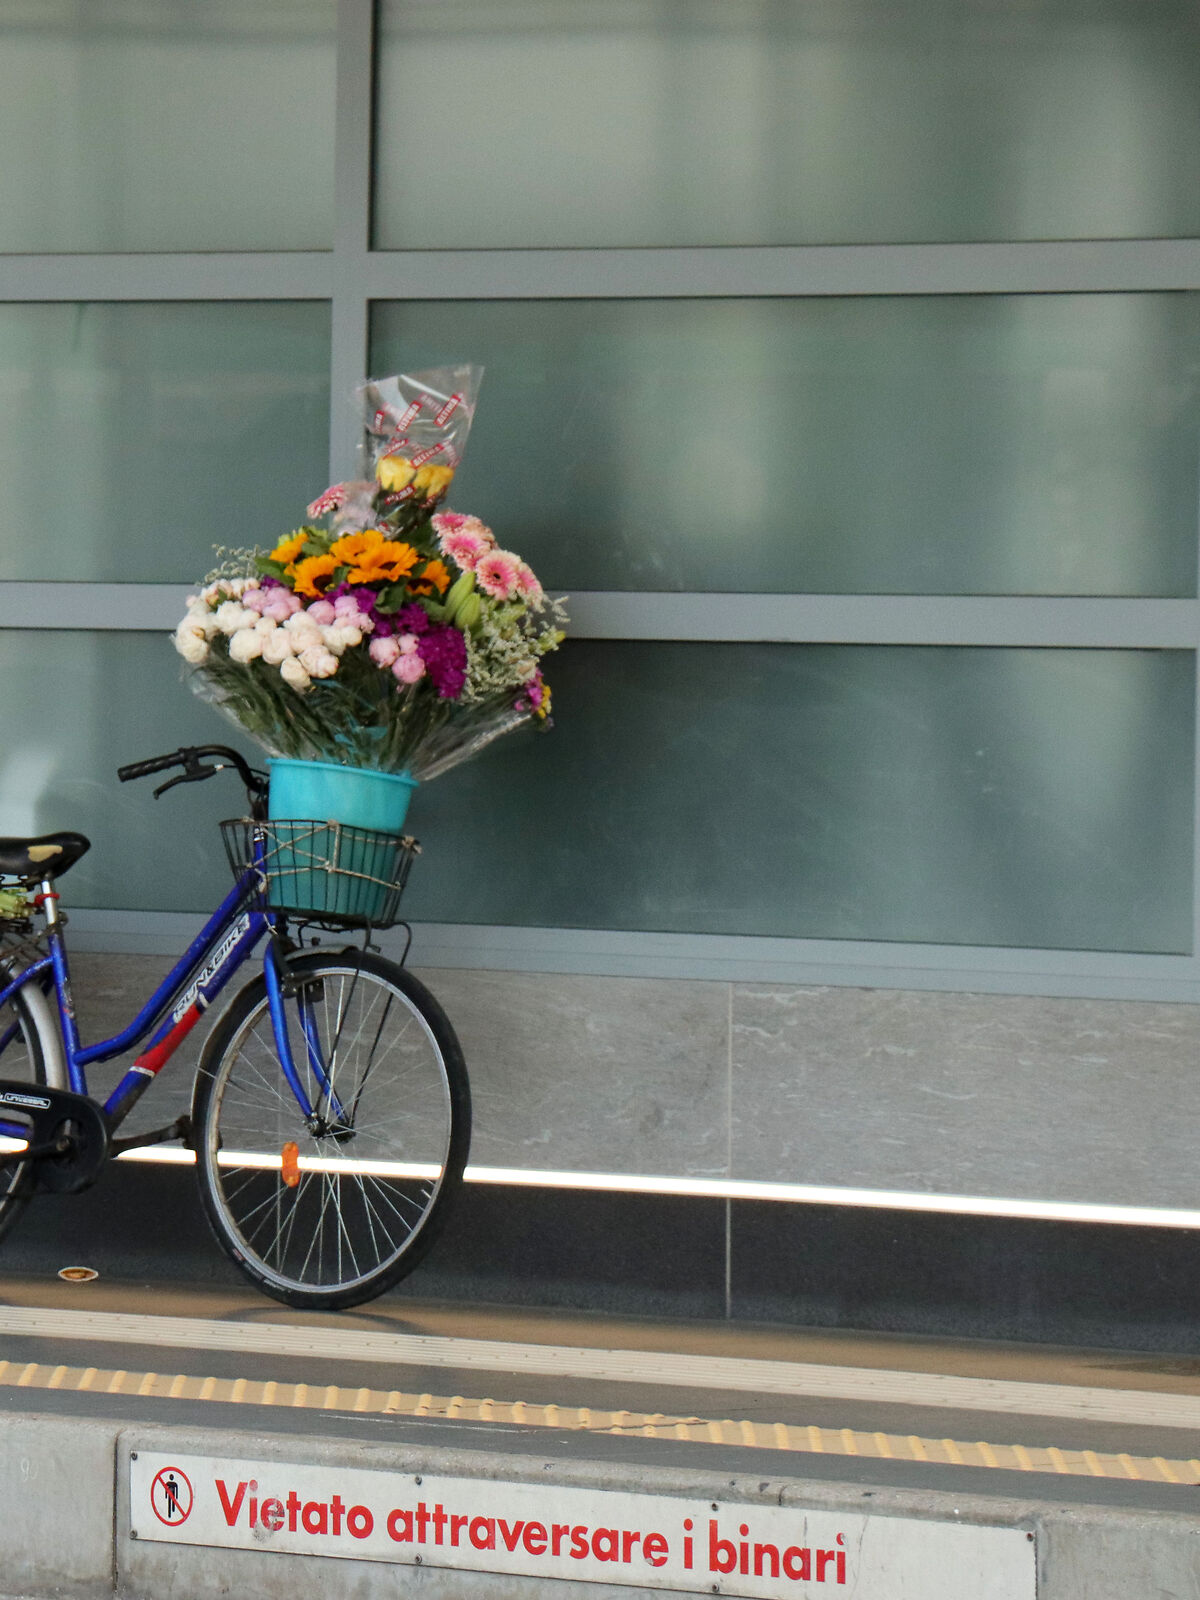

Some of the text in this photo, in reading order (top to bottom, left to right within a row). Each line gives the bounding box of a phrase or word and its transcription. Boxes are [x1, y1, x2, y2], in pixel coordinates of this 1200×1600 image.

[215, 1479, 846, 1585] Vietato attraversare i binari
